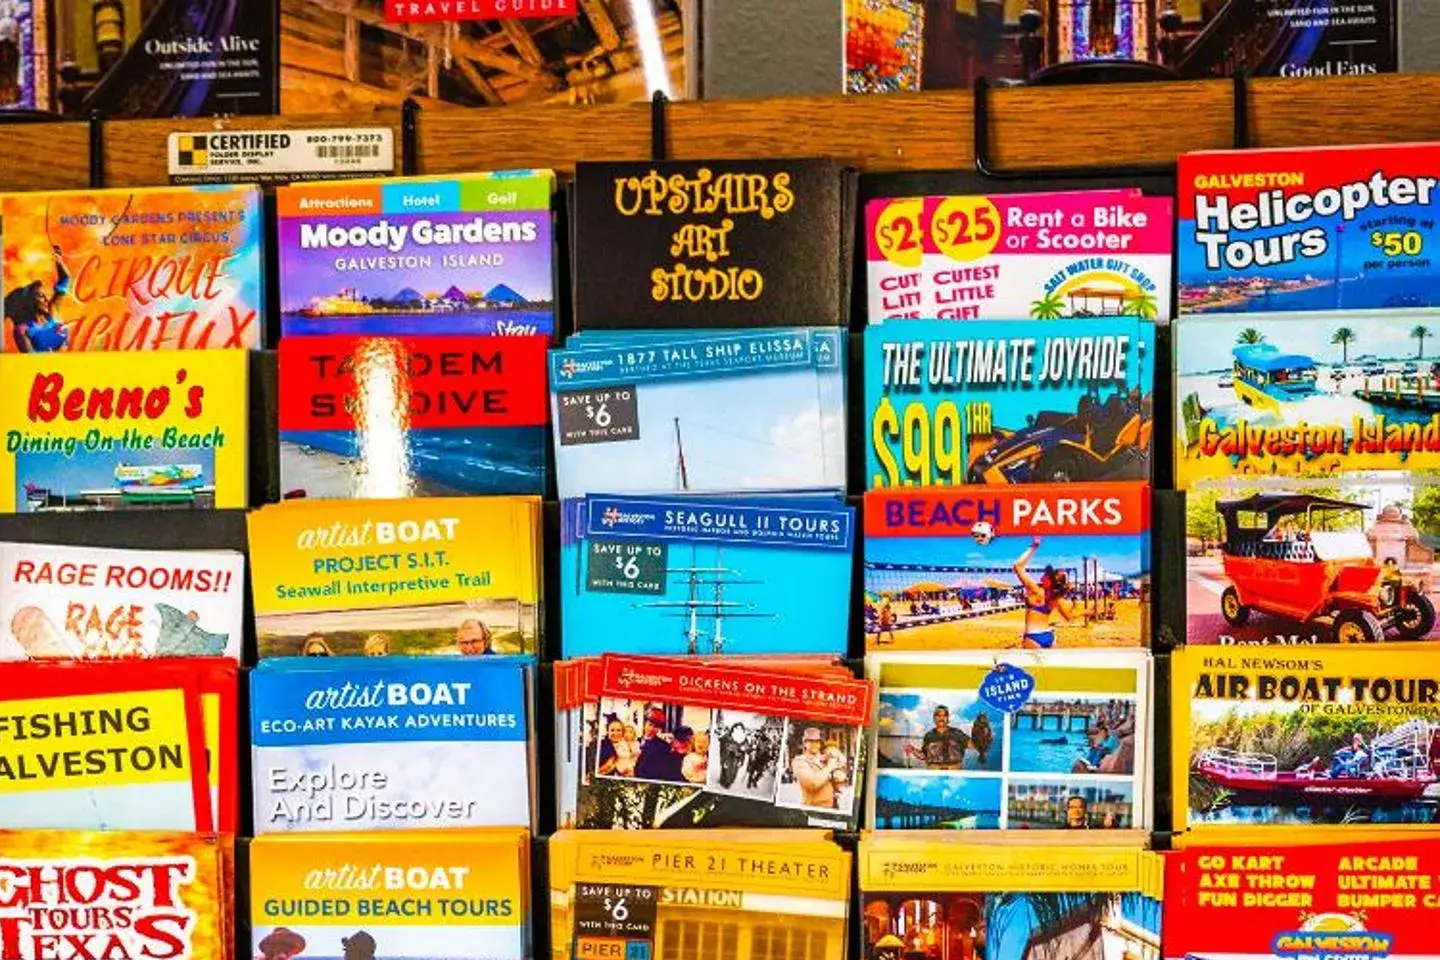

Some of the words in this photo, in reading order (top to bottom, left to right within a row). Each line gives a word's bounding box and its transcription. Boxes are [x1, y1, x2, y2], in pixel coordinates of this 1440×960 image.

[396, 1, 480, 16] TRAVEL
[1280, 61, 1331, 77] Good
[1337, 61, 1376, 75] Eats
[211, 135, 290, 149] CERTIFIED
[1194, 172, 1304, 188] GALVESTON
[615, 169, 795, 219] UPSTAIRS
[936, 206, 996, 247] $25
[1007, 207, 1064, 228] Rent
[1071, 214, 1084, 228] a
[1094, 205, 1147, 228] Bike
[1006, 234, 1029, 249] or
[1037, 228, 1132, 249] Scooter
[1371, 232, 1423, 256] $50
[335, 254, 431, 270] GALVESTON
[443, 252, 504, 267] ISLAND
[74, 254, 228, 302] CIRQUE
[618, 352, 657, 366] 1877
[663, 350, 697, 362] TALL
[706, 344, 741, 358] SHIP
[750, 340, 802, 354] ELISSA
[587, 404, 611, 427] $6
[6, 429, 81, 456] Dining
[86, 430, 117, 452] On
[121, 428, 155, 449] the
[160, 428, 225, 449] Beach
[1200, 417, 1344, 455] Galveston
[1349, 413, 1440, 454] Island
[665, 511, 746, 528] SEAGULL
[757, 517, 768, 528] II
[779, 517, 840, 532] TOURS
[885, 499, 1001, 528] BEACH
[1013, 498, 1123, 526] PARKS
[14, 560, 97, 590] RAGE
[104, 564, 232, 593] ROOMS!!
[275, 575, 343, 600] Seawall
[348, 573, 453, 599] Interpretive
[457, 571, 491, 588] Trail
[1204, 658, 1236, 669] HAL
[1241, 659, 1324, 670] NEWSOM'S
[679, 675, 740, 694] DICKENS
[745, 682, 766, 695] ON
[771, 684, 798, 698] THE
[802, 687, 858, 705] STRAND
[262, 718, 336, 734] ECO-ART
[341, 716, 399, 730] KAYAK
[405, 713, 517, 728] ADVENTURES
[270, 795, 339, 822] And
[344, 797, 477, 820] Discover
[652, 854, 696, 869] PIER
[708, 856, 726, 870] 21
[738, 858, 829, 878] THEATER
[1338, 857, 1418, 870] ARCADE
[1200, 875, 1239, 889] AXE
[1247, 875, 1315, 889] THROW
[1338, 875, 1431, 889] ULTIMATE
[264, 899, 350, 917] GUIDED
[356, 898, 432, 916] BEACH
[437, 898, 512, 916] TOURS
[663, 888, 743, 907] STATION
[1199, 892, 1237, 907] FUN
[1244, 893, 1313, 907] DIGGER
[1337, 893, 1416, 908] BUMPER
[31, 907, 132, 929] TOURS
